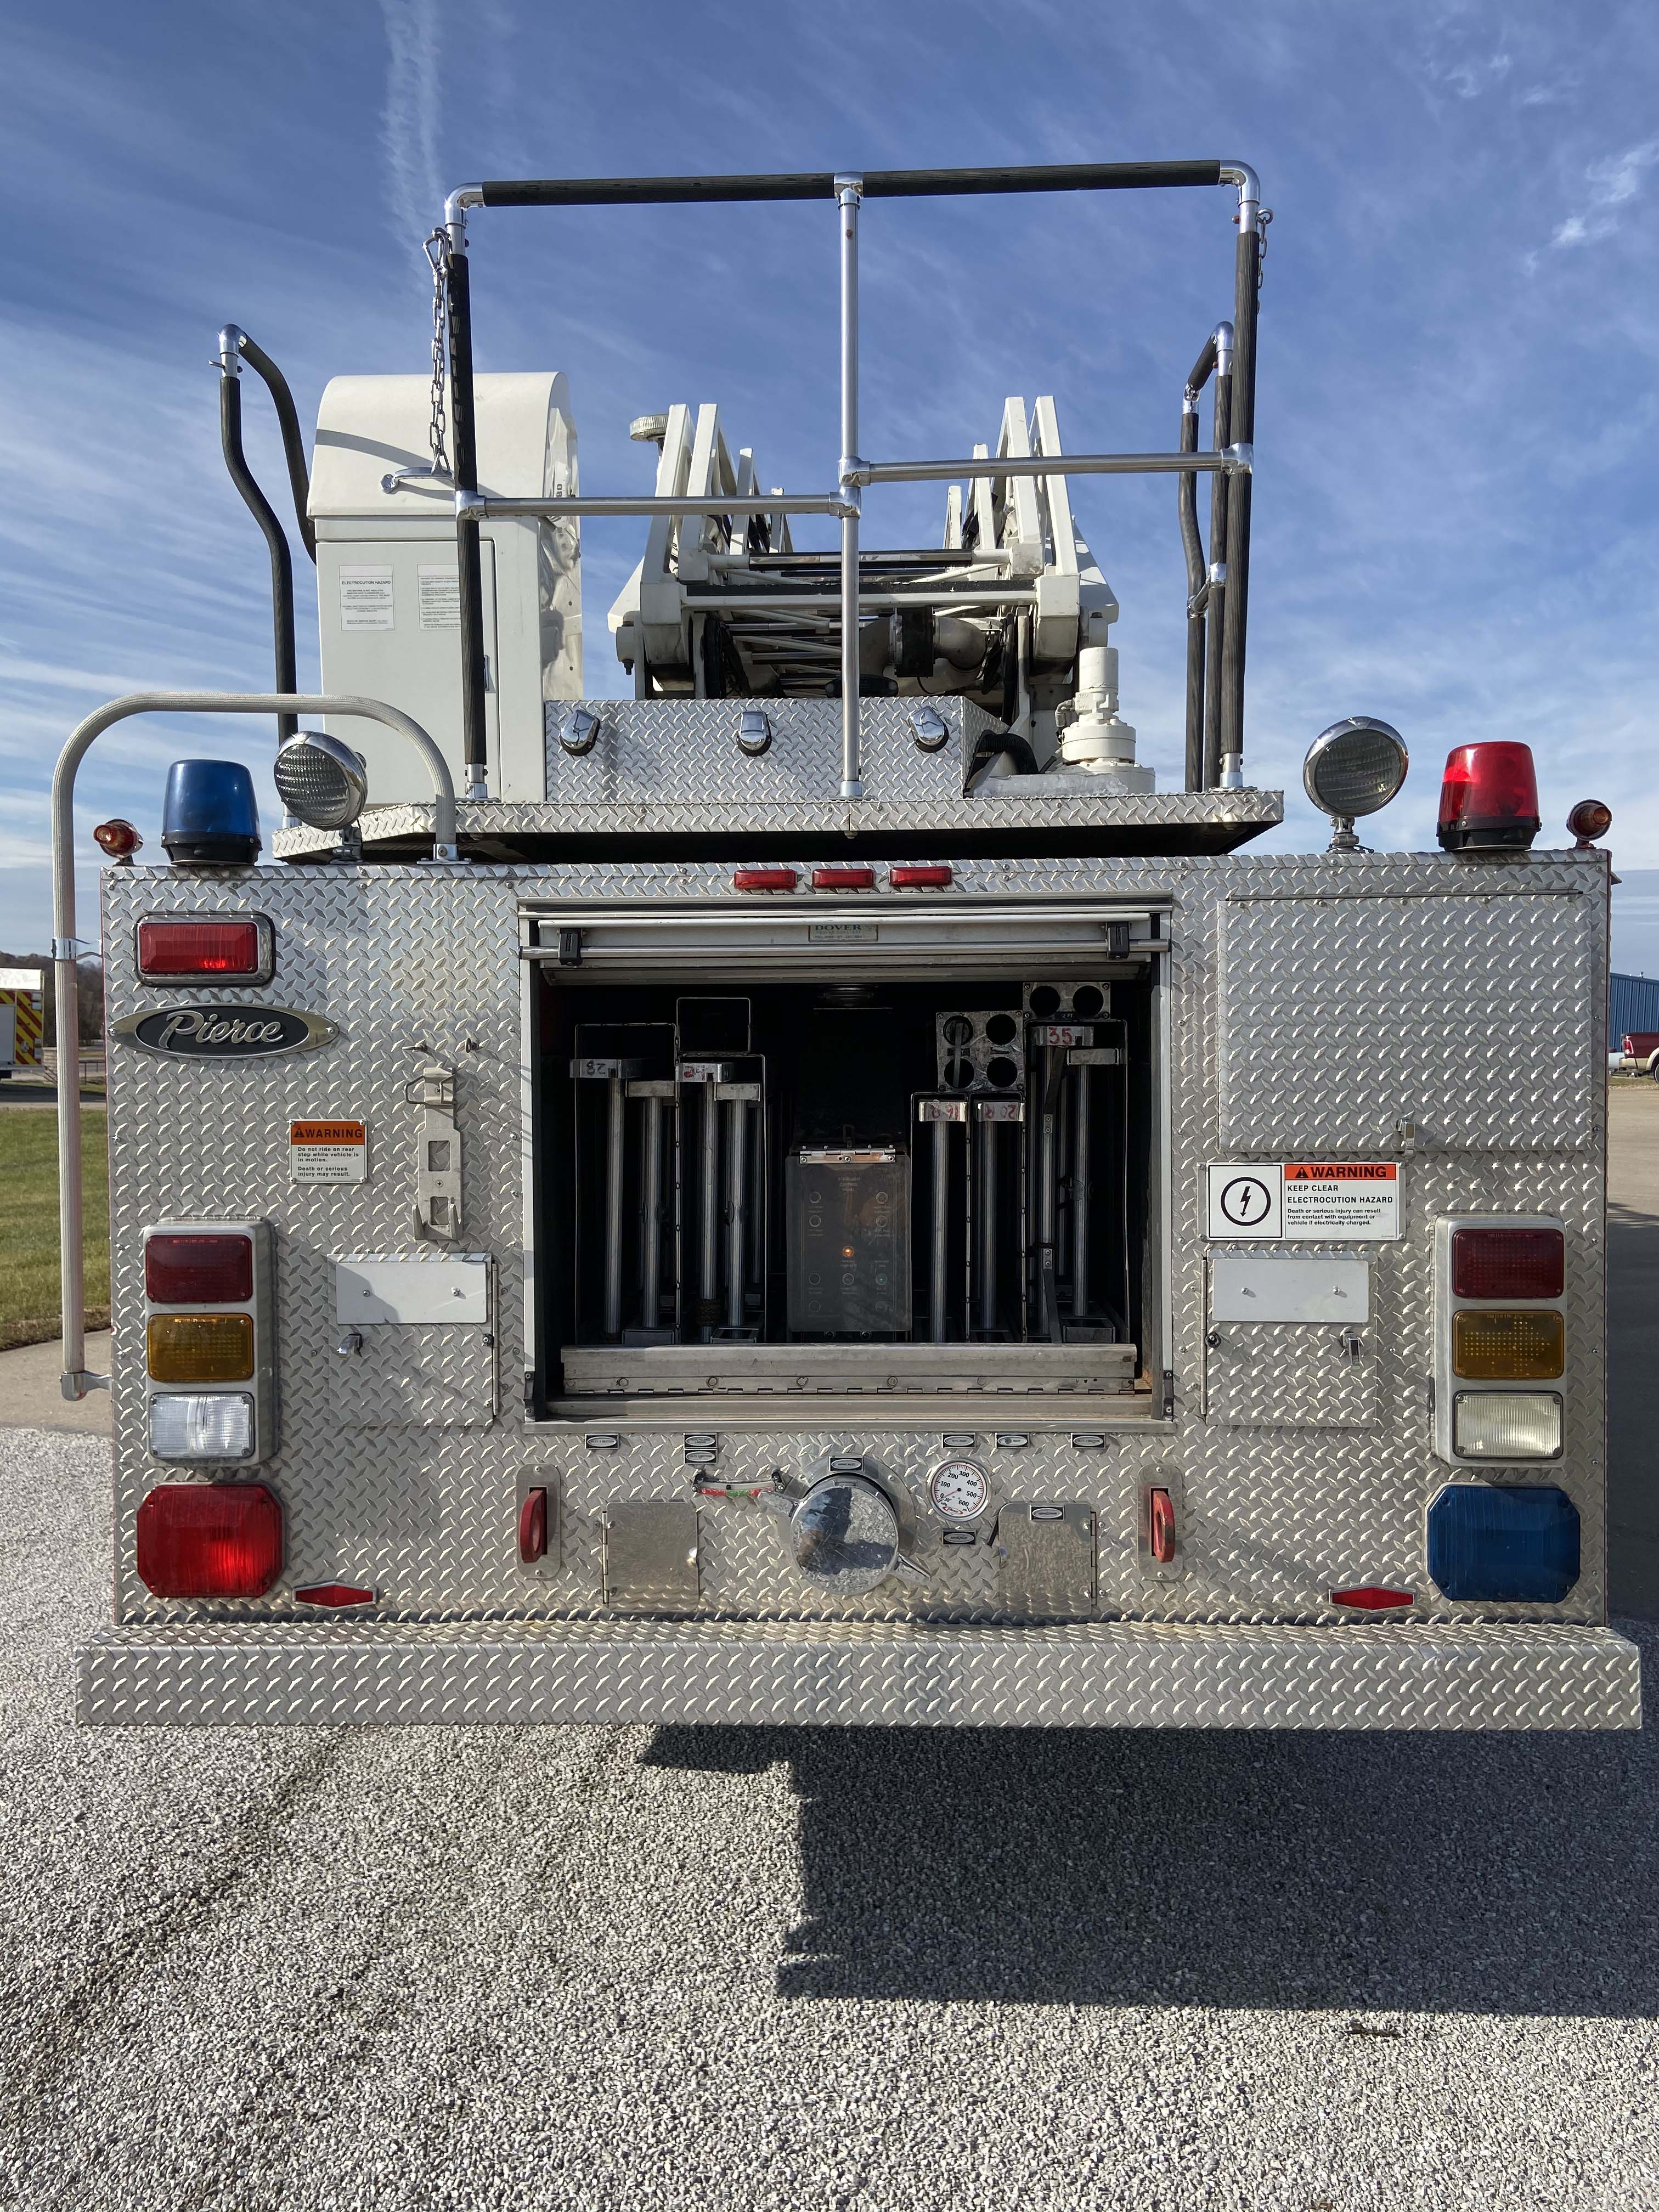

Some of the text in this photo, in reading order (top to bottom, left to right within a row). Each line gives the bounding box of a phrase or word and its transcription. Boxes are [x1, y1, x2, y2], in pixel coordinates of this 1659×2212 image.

[158, 1010, 284, 1049] Pierce
[1049, 1027, 1073, 1045] 35
[305, 1128, 362, 1138] WARNING
[1311, 1166, 1386, 1178] WARNING
